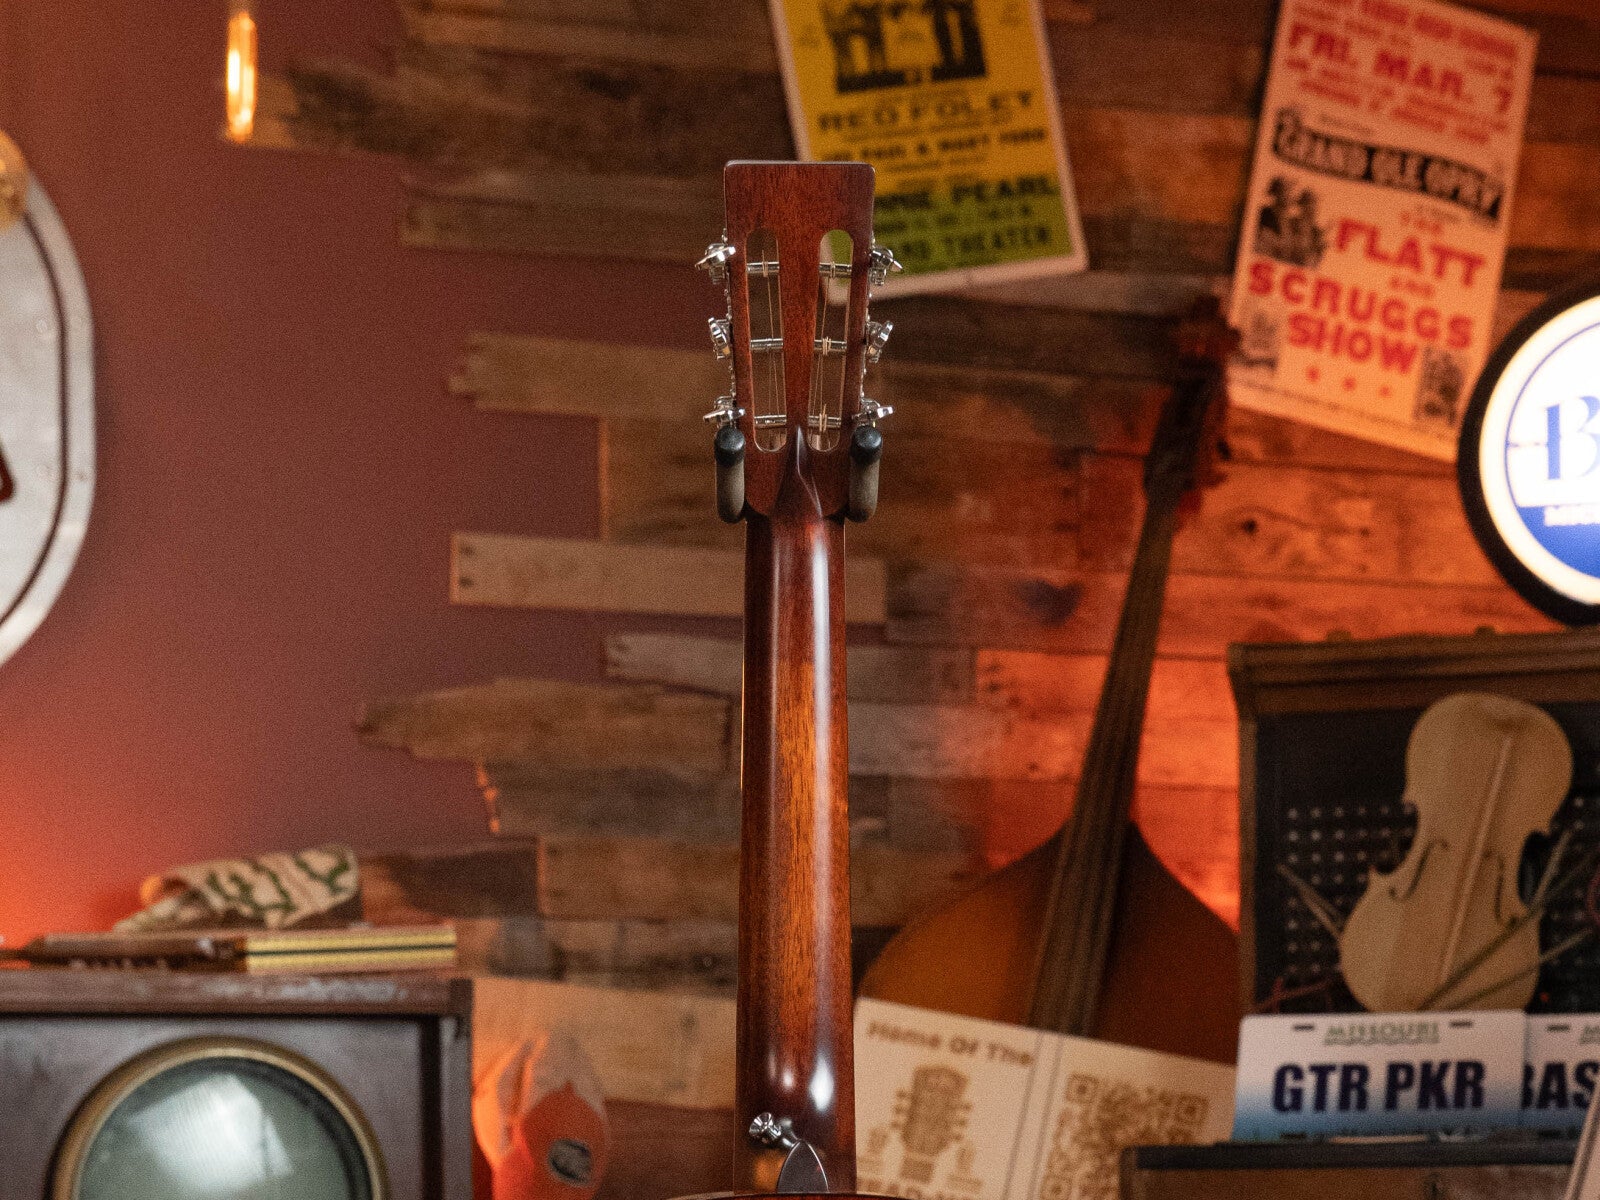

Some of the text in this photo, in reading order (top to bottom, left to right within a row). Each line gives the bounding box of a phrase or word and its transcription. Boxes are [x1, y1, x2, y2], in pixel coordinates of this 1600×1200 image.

[1335, 218, 1486, 287] FLATT
[1249, 261, 1474, 348] SCRUGGS
[1288, 314, 1419, 375] SHOW
[866, 1021, 1036, 1066] Home Of The
[1326, 1021, 1440, 1039] MISSOURI
[1273, 1060, 1486, 1113] GTR PKR
